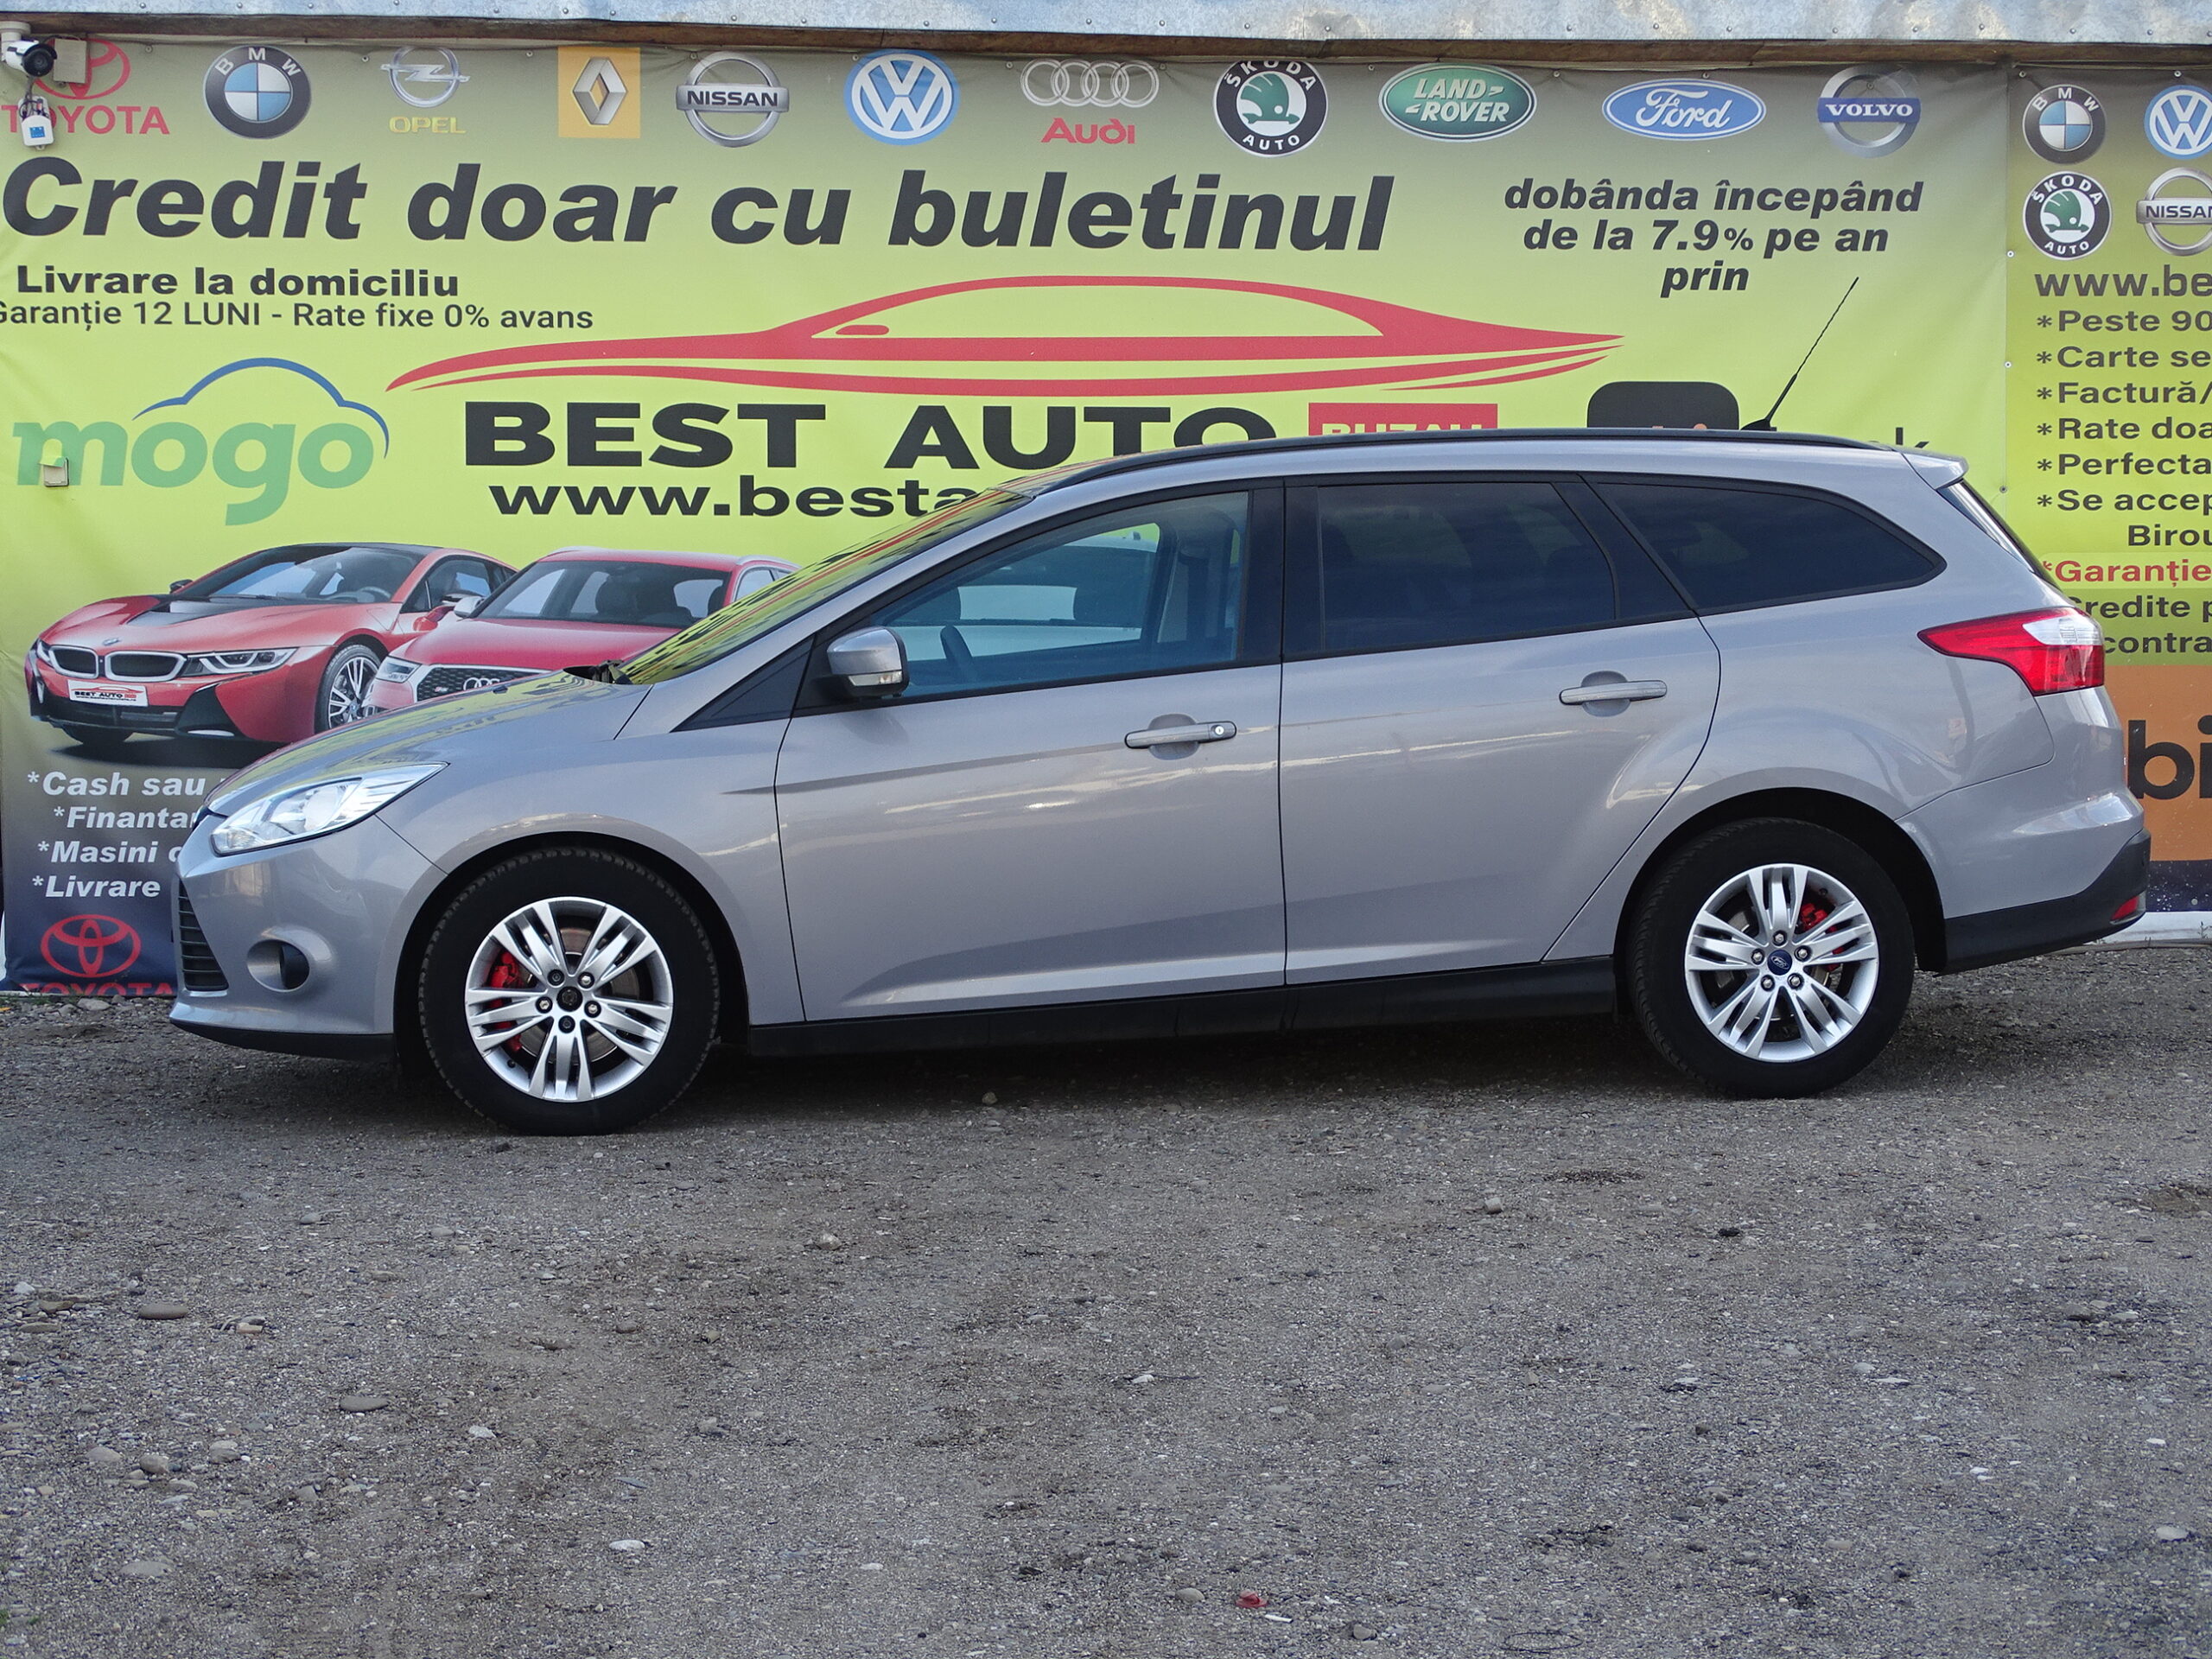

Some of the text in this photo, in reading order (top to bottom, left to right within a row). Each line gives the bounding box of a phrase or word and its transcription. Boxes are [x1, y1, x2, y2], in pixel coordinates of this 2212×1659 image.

[214, 47, 302, 76] BMW
[686, 90, 779, 108] NISSAN
[1414, 78, 1486, 99] LAND
[2031, 87, 2100, 111] BMW
[1, 105, 170, 135] TYOTA
[1420, 102, 1510, 123] ROVER
[1636, 86, 1730, 130] Ford
[1825, 103, 1914, 118] VOLVO
[388, 116, 467, 134] OPEL
[1040, 118, 1135, 144] Audi
[1243, 134, 1300, 150] AUTO
[3, 156, 1395, 251] Credit doar cu buletinul
[1504, 178, 1924, 219] dobânda începând
[2031, 175, 2103, 205] ŠKODA
[1523, 219, 1889, 259] de la 7.9% pe an
[2044, 240, 2090, 255] AUTO
[17, 265, 459, 296] Livrare la domiciliu
[1660, 261, 1750, 298] prin
[133, 302, 173, 325] 12
[184, 302, 260, 326] LUNI
[294, 302, 365, 327] Rate
[375, 302, 434, 327] fixe
[444, 303, 490, 327] 0%
[500, 310, 594, 328] avans
[465, 401, 826, 467] BEST
[13, 421, 374, 525] mogo
[141, 778, 207, 796] sau
